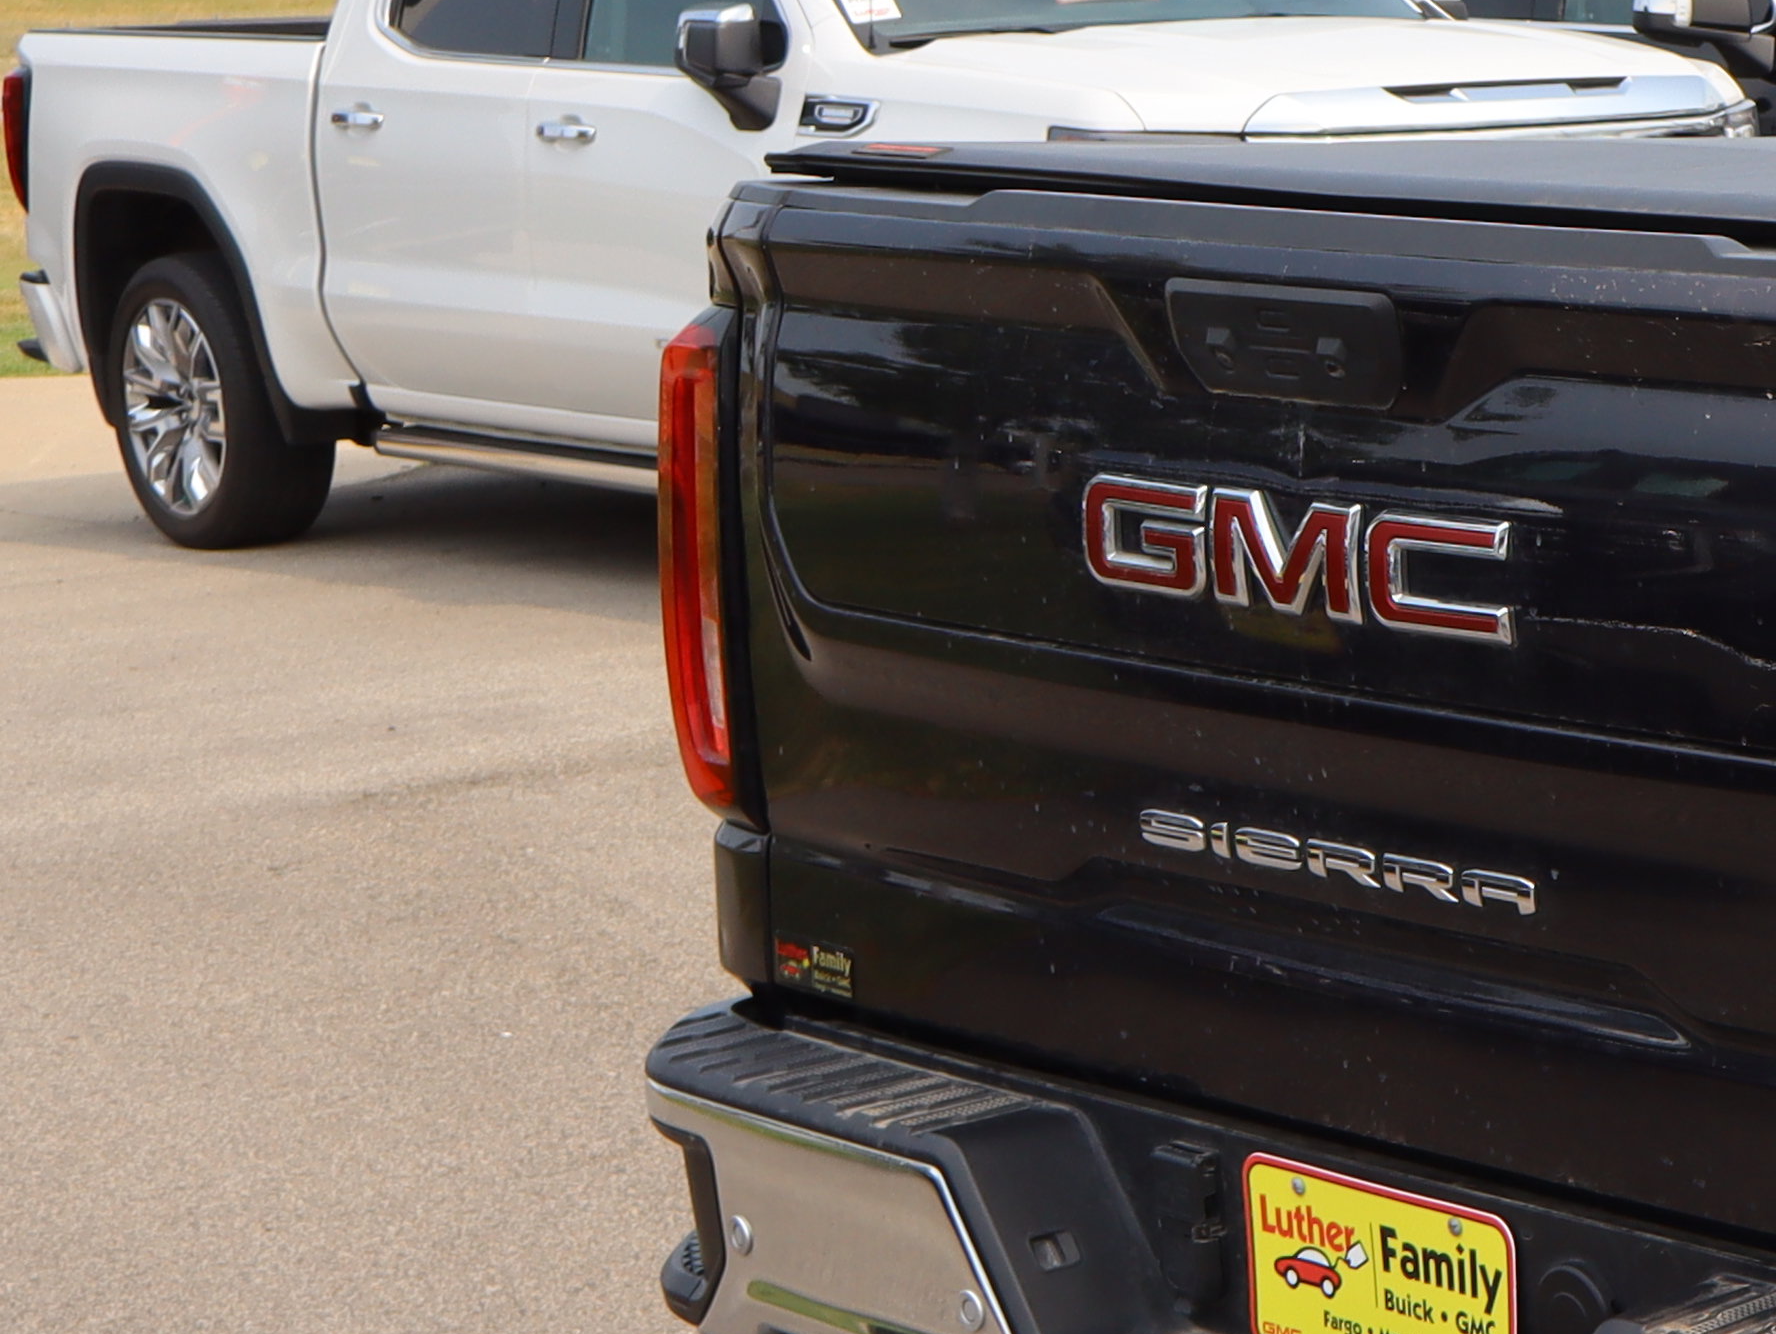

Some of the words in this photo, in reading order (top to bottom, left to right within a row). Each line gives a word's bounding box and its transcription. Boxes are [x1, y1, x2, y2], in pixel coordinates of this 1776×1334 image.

[1082, 474, 1516, 646] GMC
[1139, 808, 1538, 916] SIERRA
[1259, 1193, 1356, 1253] Luther
[1379, 1224, 1503, 1316] Family
[1384, 1288, 1434, 1324] Buick
